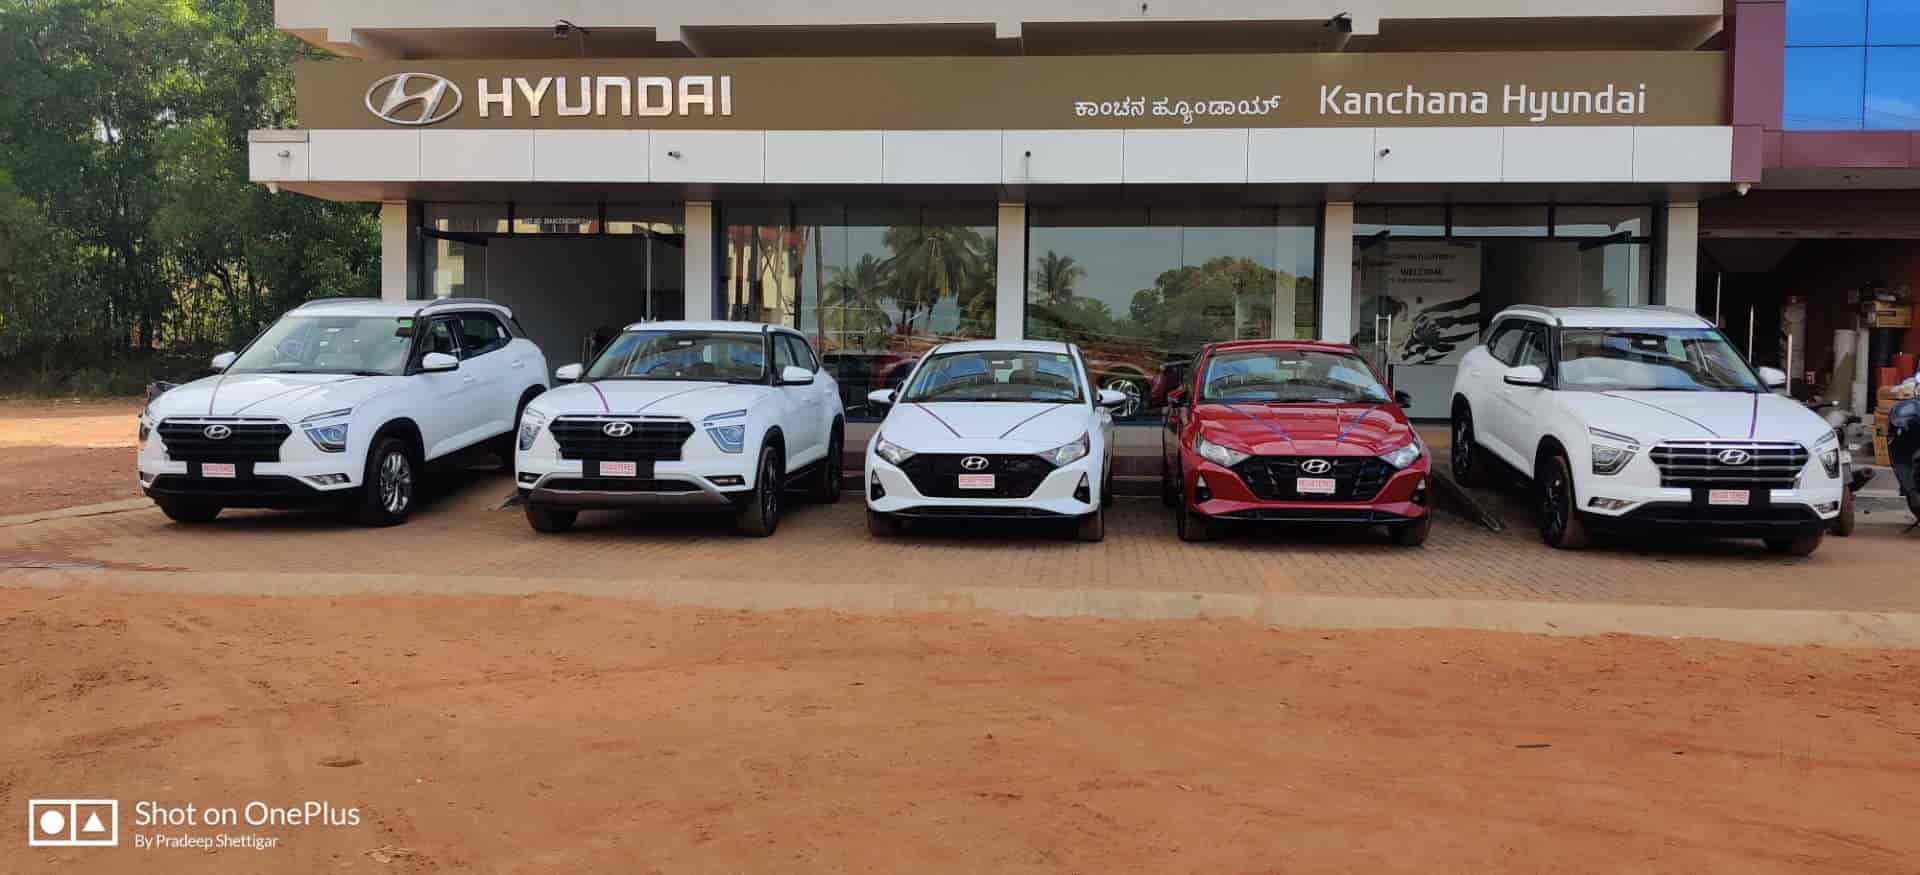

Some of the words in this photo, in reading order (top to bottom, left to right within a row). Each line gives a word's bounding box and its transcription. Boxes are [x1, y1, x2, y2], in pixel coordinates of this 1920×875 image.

[477, 75, 732, 118] HYUNDAI
[1074, 96, 1146, 117] ಕಾಂಚನ
[1319, 84, 1489, 115] Kanchana
[1502, 84, 1646, 122] Hyundai
